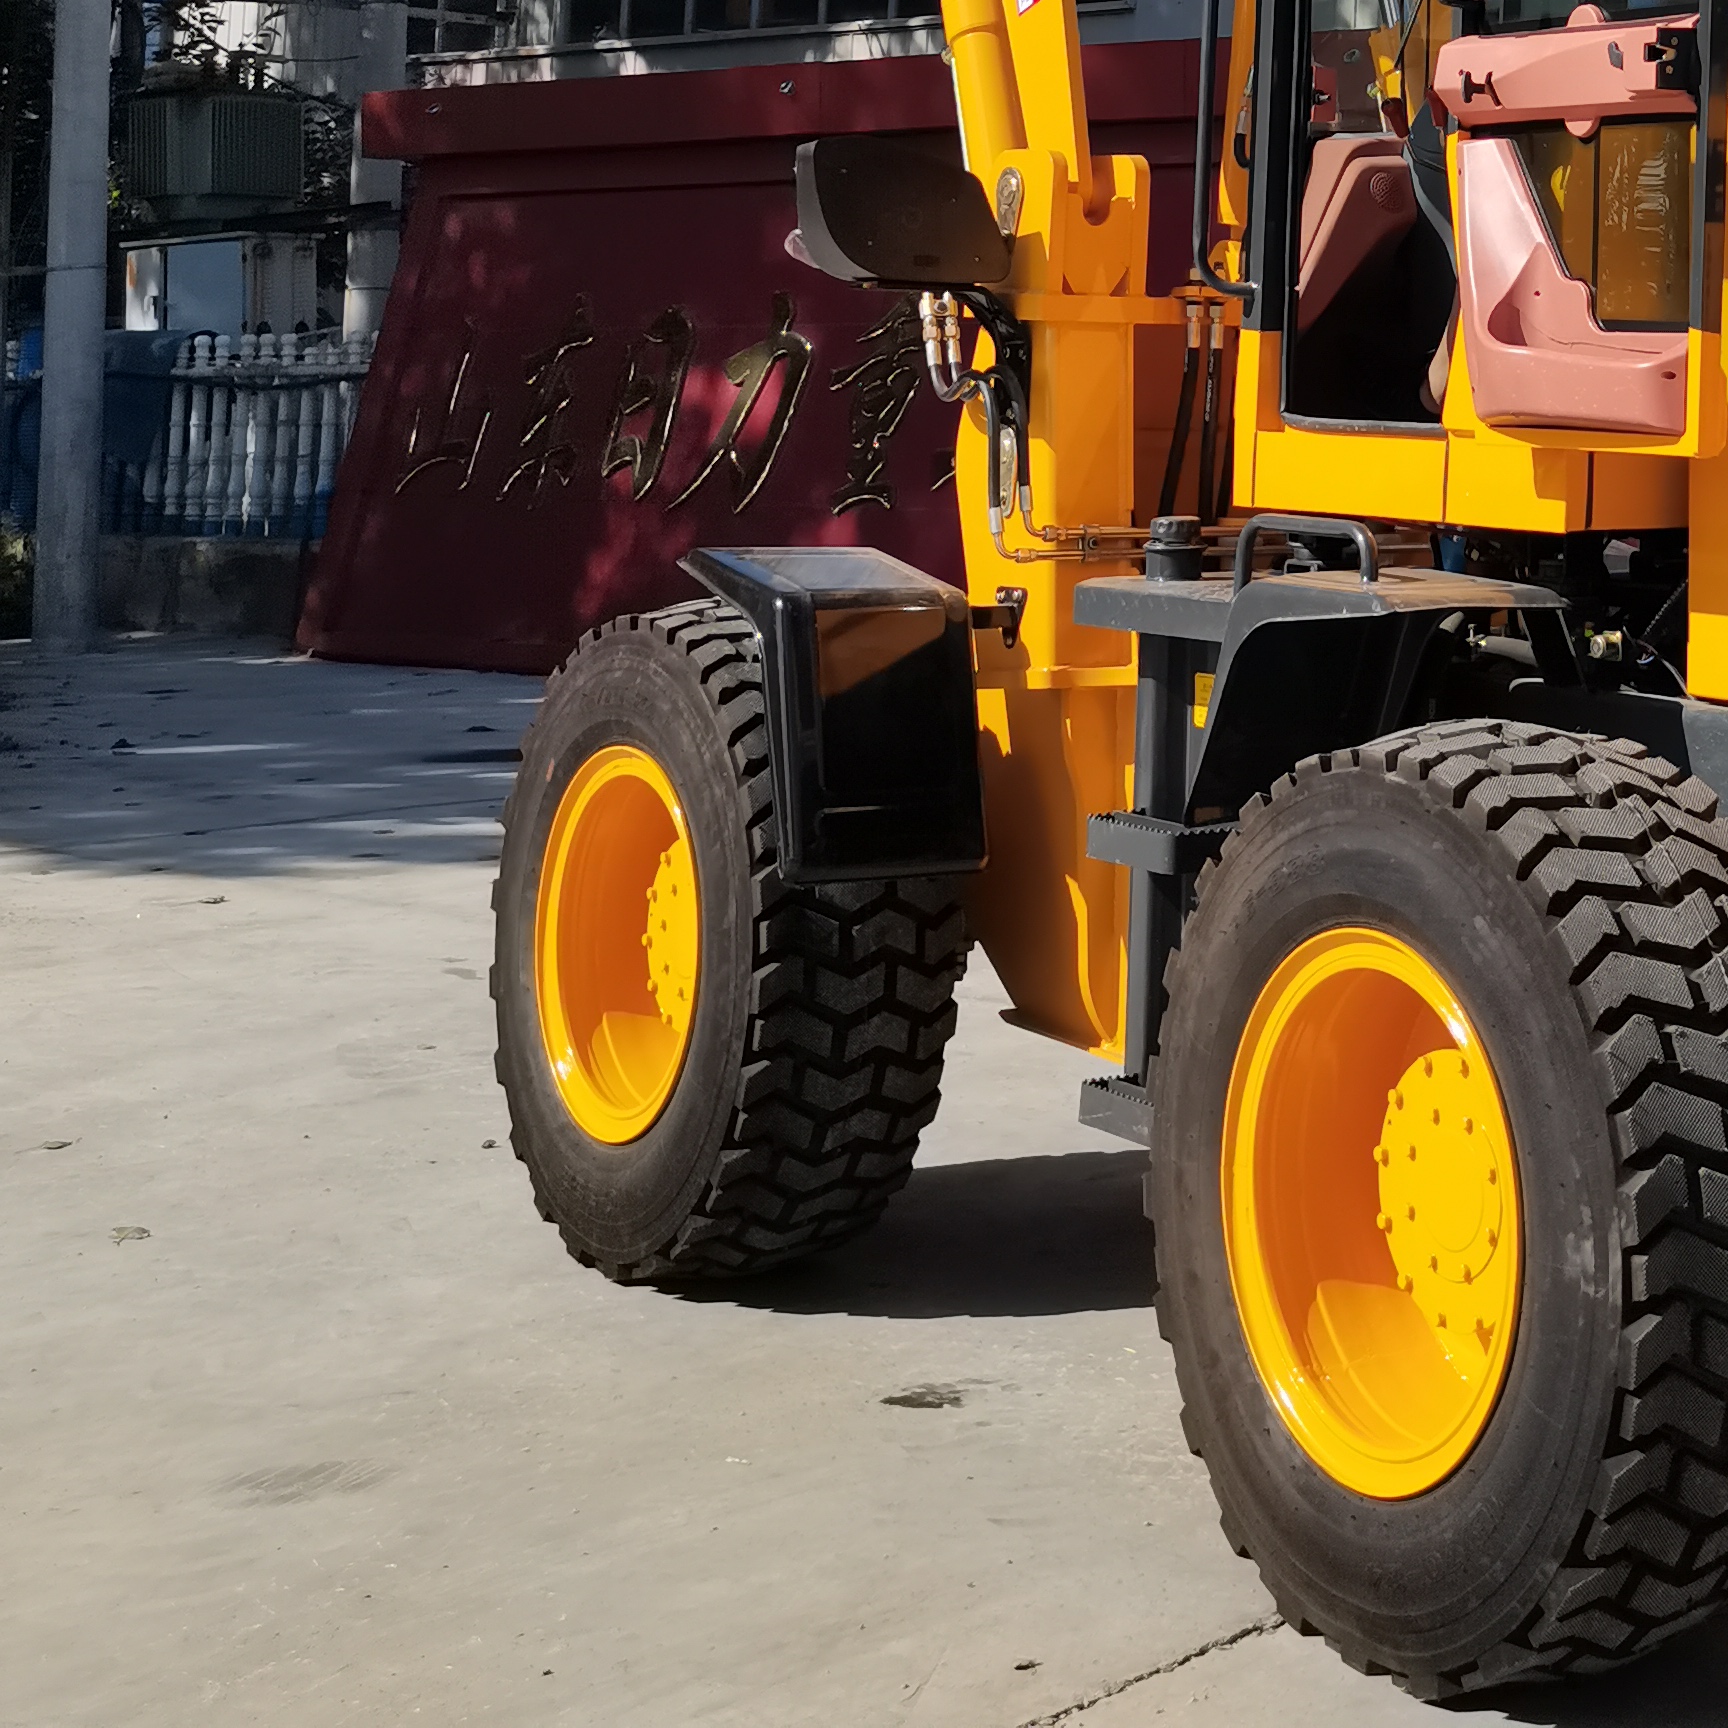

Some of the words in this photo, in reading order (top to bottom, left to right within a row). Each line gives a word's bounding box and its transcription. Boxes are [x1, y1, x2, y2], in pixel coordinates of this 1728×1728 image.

[394, 289, 957, 515] 山东日力重
